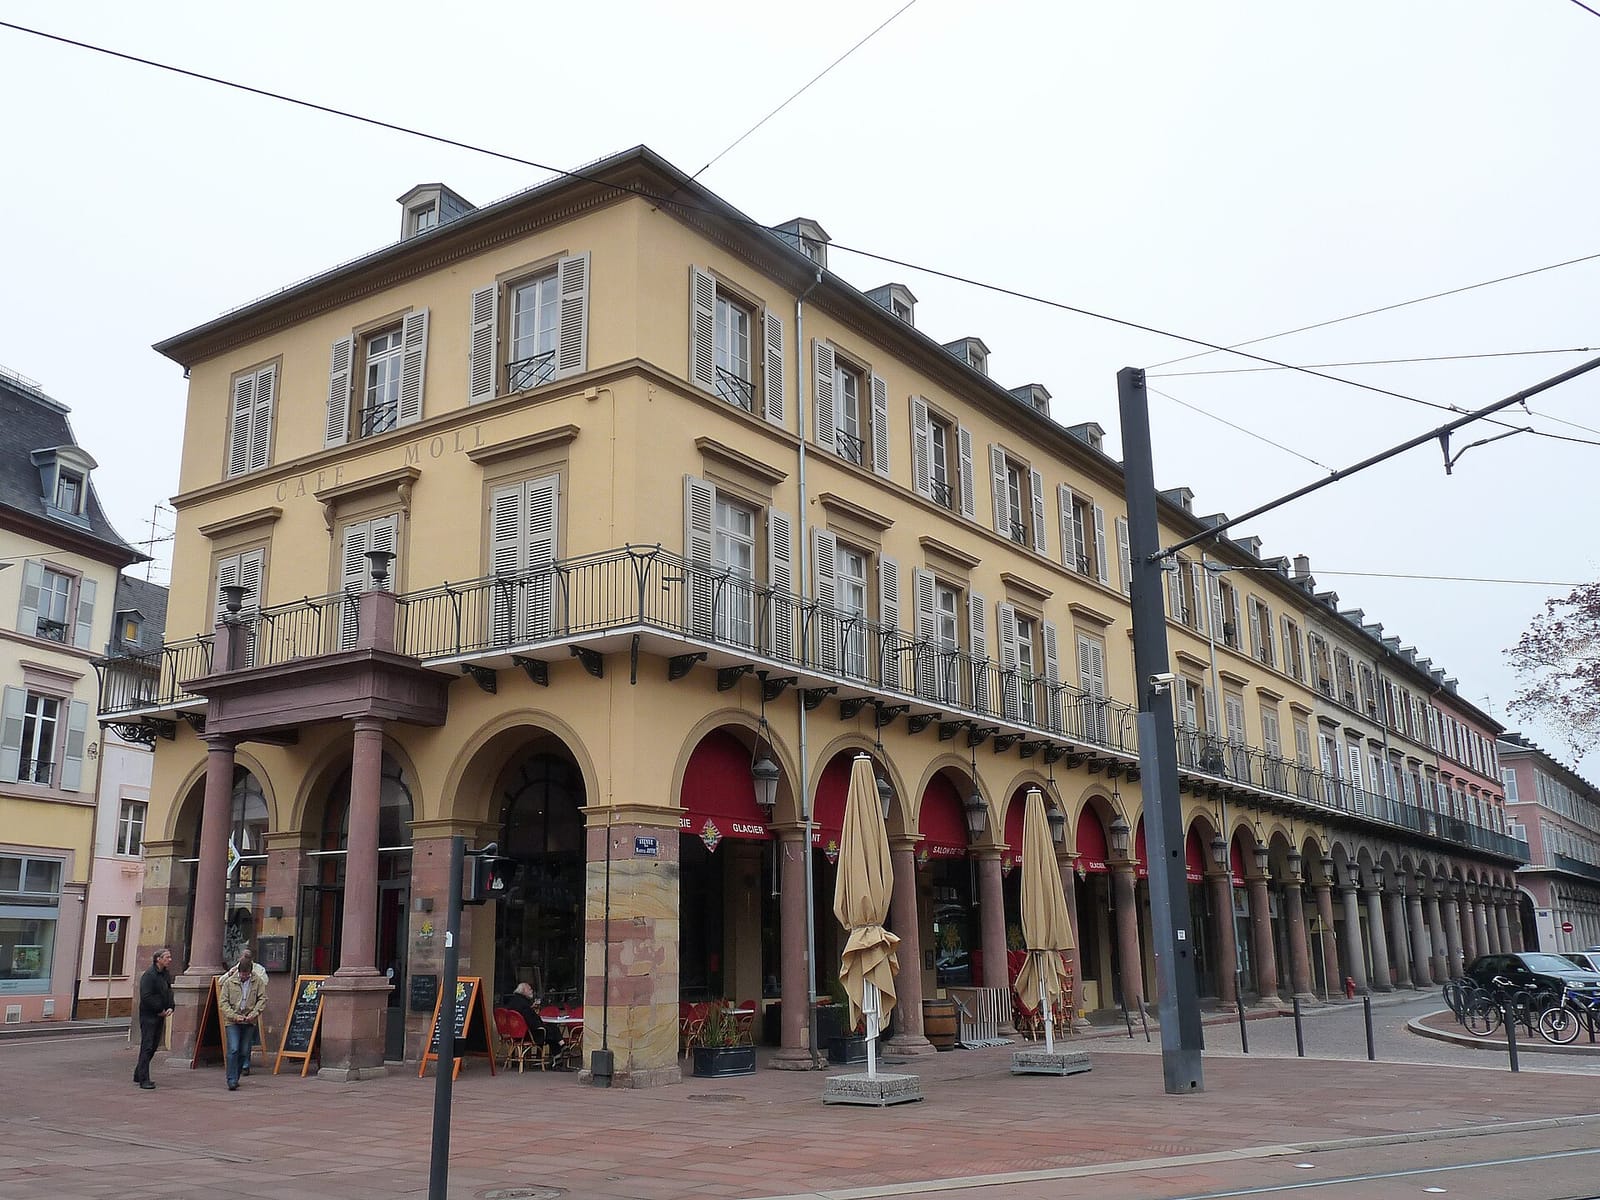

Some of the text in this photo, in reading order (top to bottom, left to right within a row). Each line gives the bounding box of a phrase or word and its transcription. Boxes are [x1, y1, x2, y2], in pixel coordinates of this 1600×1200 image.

[403, 424, 486, 466] MOLL
[732, 823, 765, 835] GLACIER
[932, 845, 950, 855] SALON
